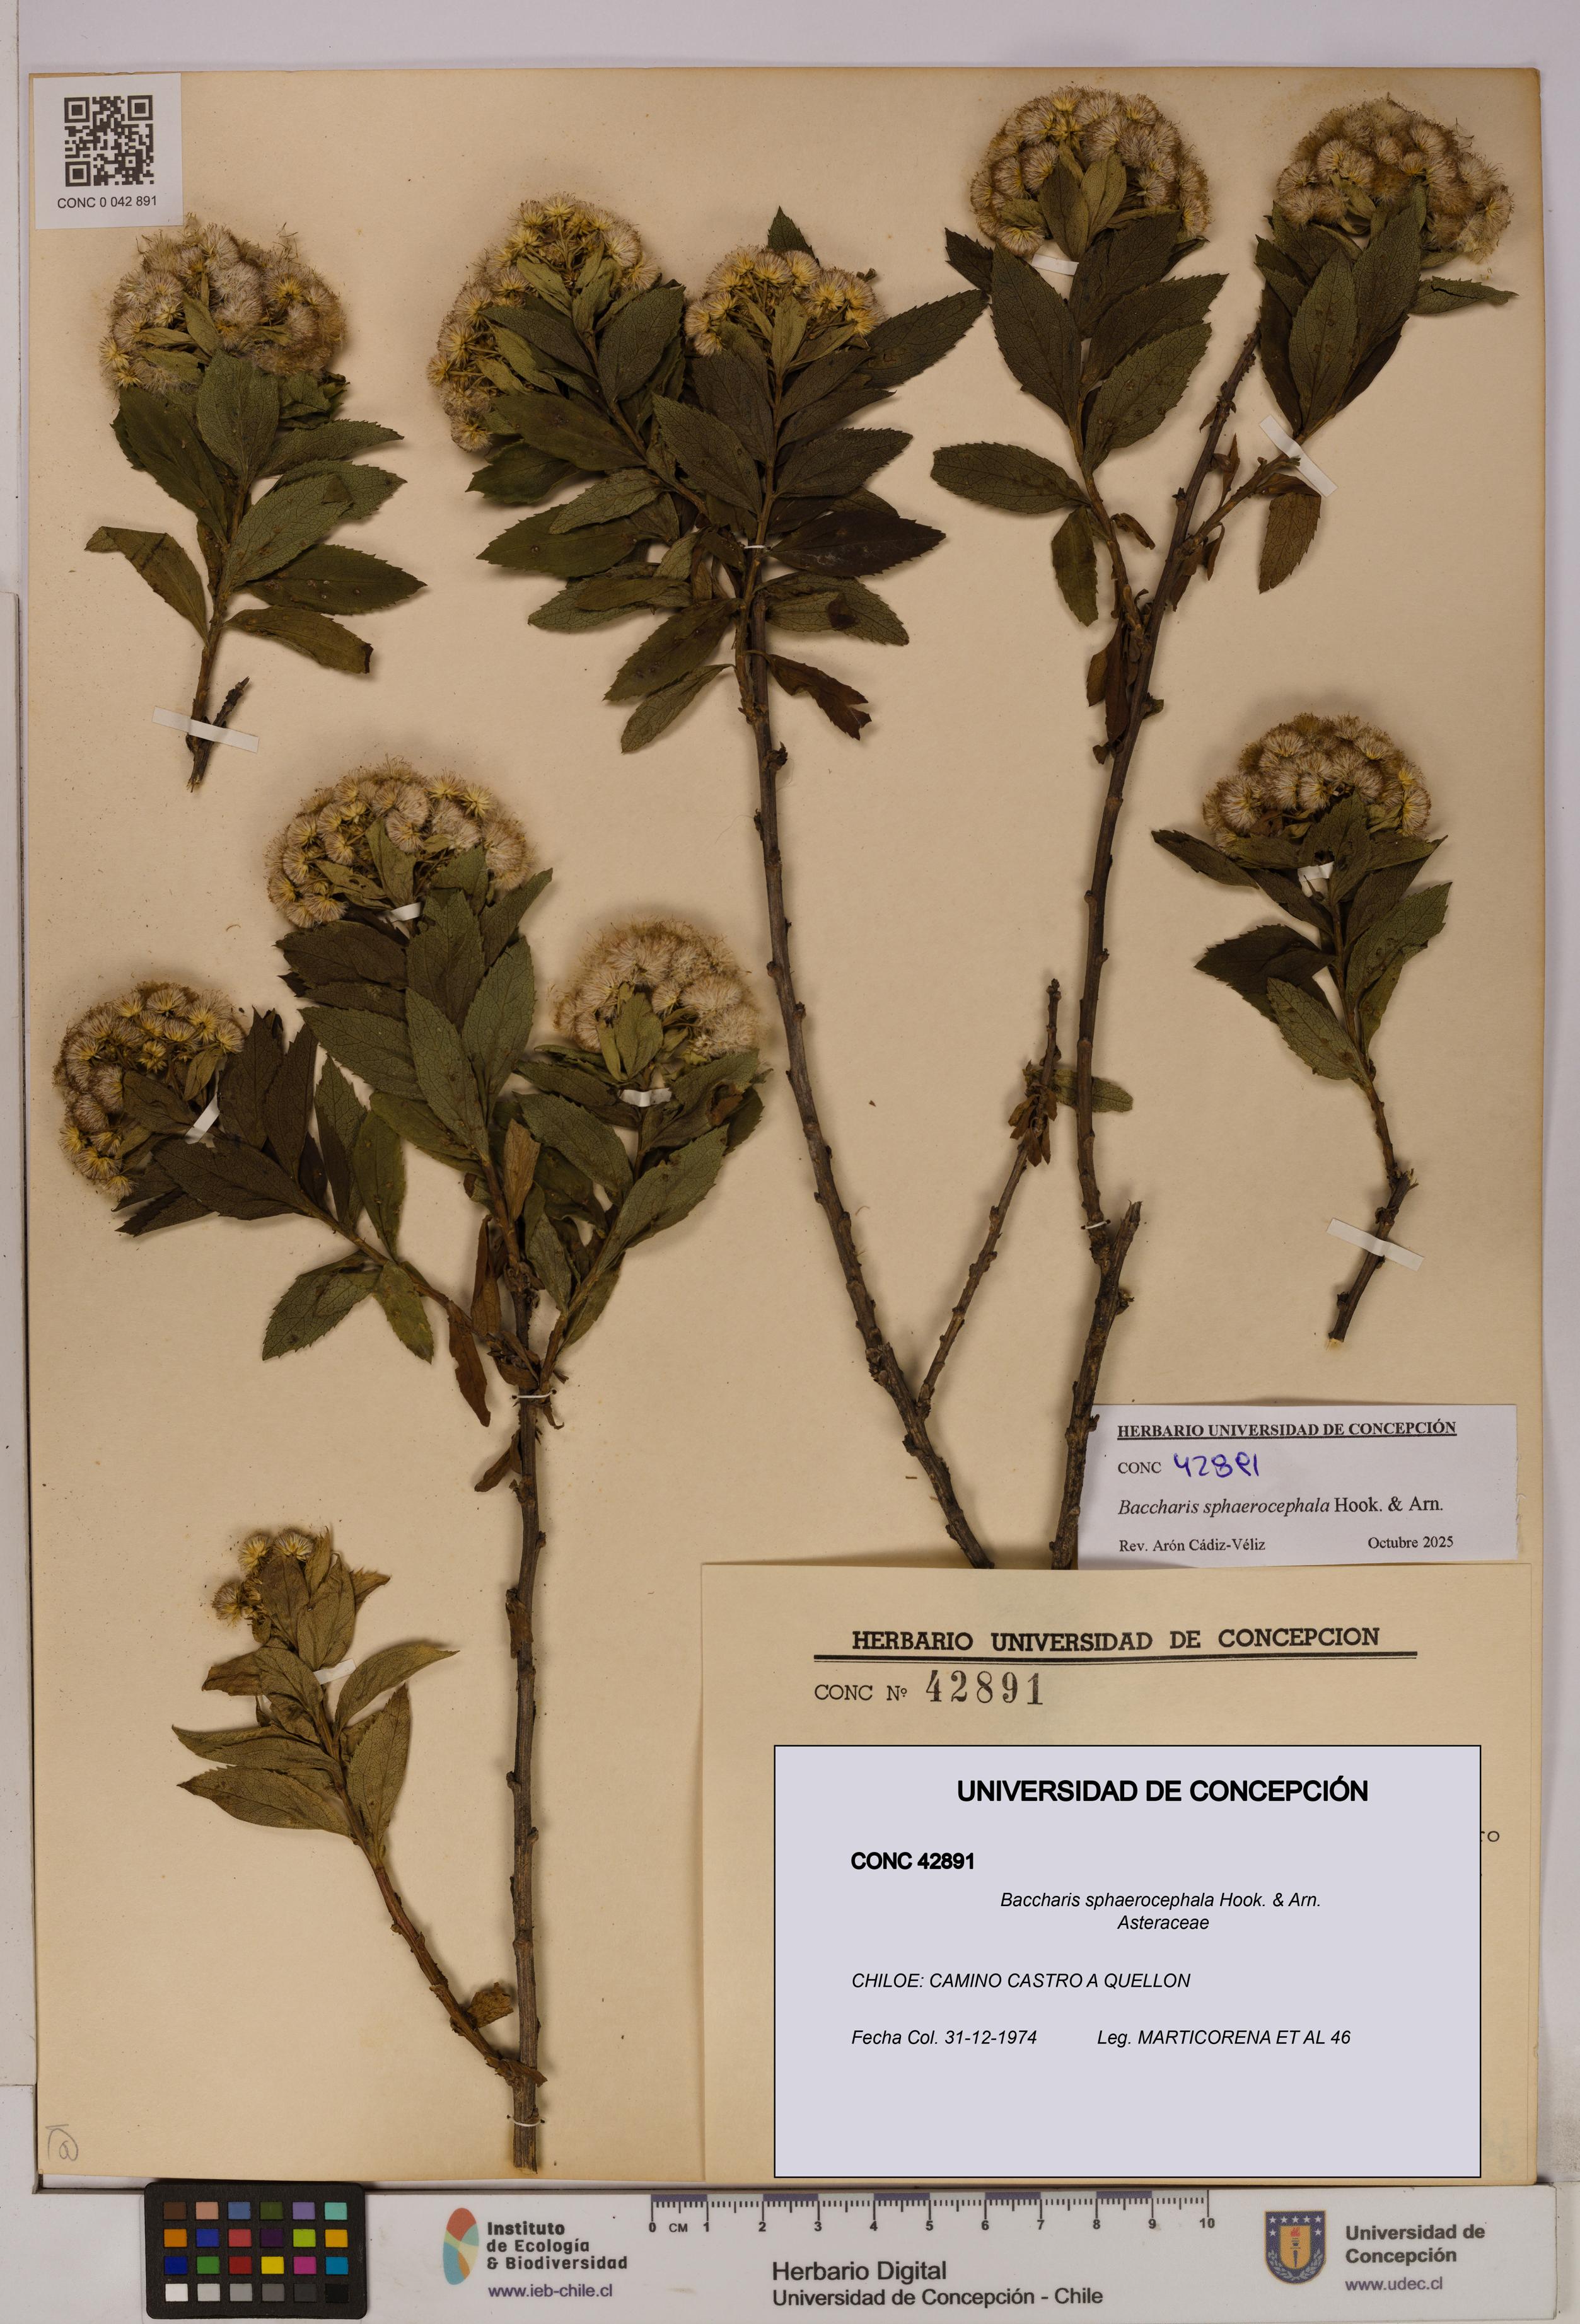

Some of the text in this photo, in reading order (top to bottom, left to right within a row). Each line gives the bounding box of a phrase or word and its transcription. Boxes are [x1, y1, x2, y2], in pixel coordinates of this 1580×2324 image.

[58, 195, 156, 208] CONC 0 042 891
[1117, 1418, 1457, 1437] HERBARIO UNIVERSIDAD DE CONCEPCIÓN
[1118, 1452, 1258, 1477] CONC 42891
[1118, 1496, 1443, 1517] Baccharis sphaerocephala Hook. & Arn.
[1120, 1538, 1265, 1552] Rev. Arón Cádiz-Véliz
[1368, 1536, 1453, 1549] Octubre 2025
[852, 1627, 1380, 1651] HERBARIO UNIVERSIDAD DE CONCEPCION
[815, 1684, 873, 1701] CONC
[926, 1670, 1043, 1704] 42891
[487, 2222, 565, 2236] Instituto
[648, 2217, 1216, 2233] 0 CM 1 2 3 4 5 6 7 8 9 10
[1346, 2223, 1486, 2240] Universidad de
[487, 2238, 590, 2255] de Ecología
[487, 2256, 627, 2270] & Biodiversidad
[1345, 2248, 1456, 2266] Concepción
[773, 2261, 946, 2285] Herbario Digital
[488, 2284, 612, 2297] www.ieb-chile.cl
[1345, 2276, 1443, 2291] www.udec.cl
[774, 2289, 885, 2306] Universidad
[892, 2289, 915, 2305] de
[922, 2288, 1034, 2308] Concepción
[1055, 2287, 1103, 2304] Chile
